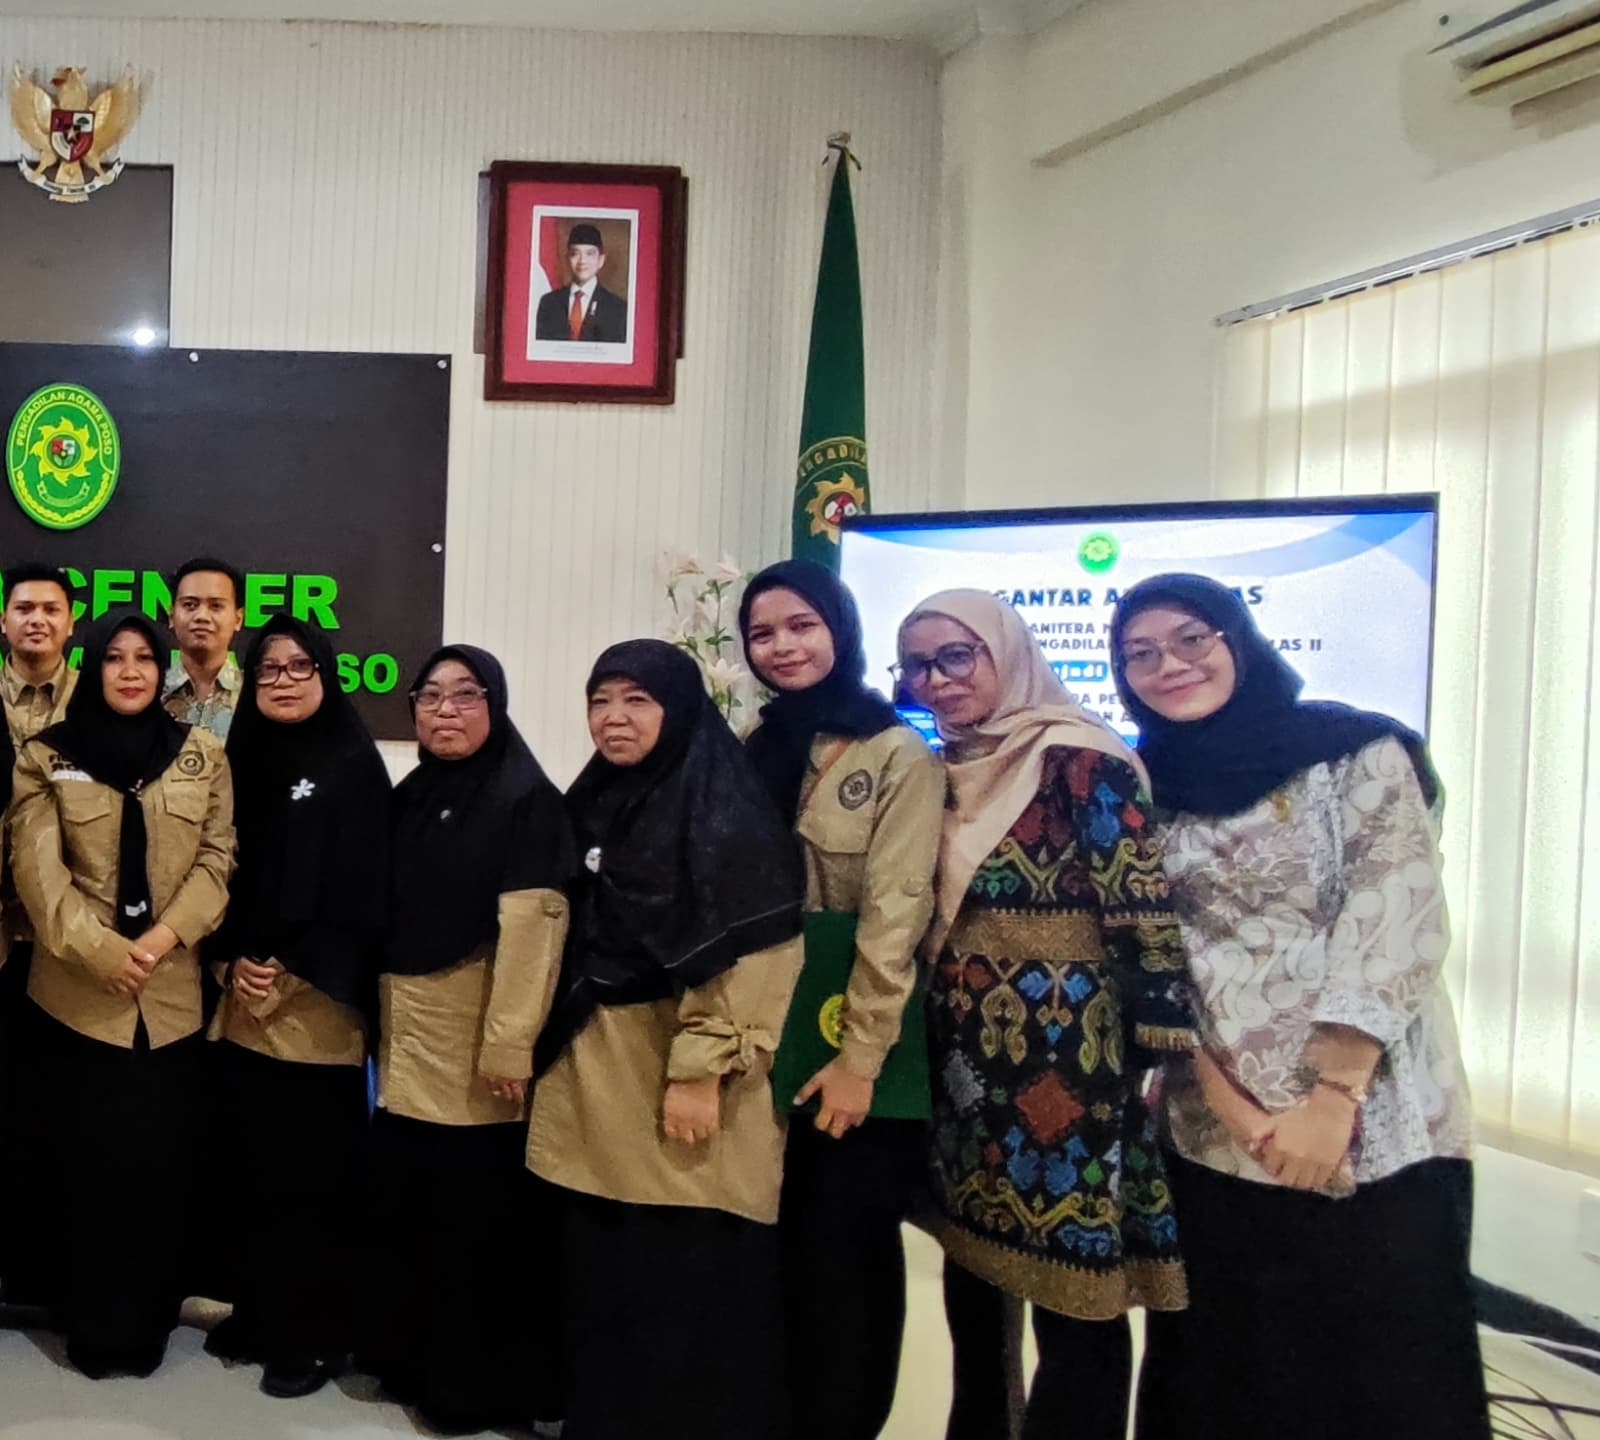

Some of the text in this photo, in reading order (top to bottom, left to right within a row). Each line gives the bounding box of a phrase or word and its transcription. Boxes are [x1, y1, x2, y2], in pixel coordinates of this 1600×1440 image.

[16, 391, 113, 455] PENGADILAN AGAMA POSO
[994, 588, 1092, 607] GANTAR
[1029, 622, 1095, 635] ANITERA
[336, 653, 399, 694] SO
